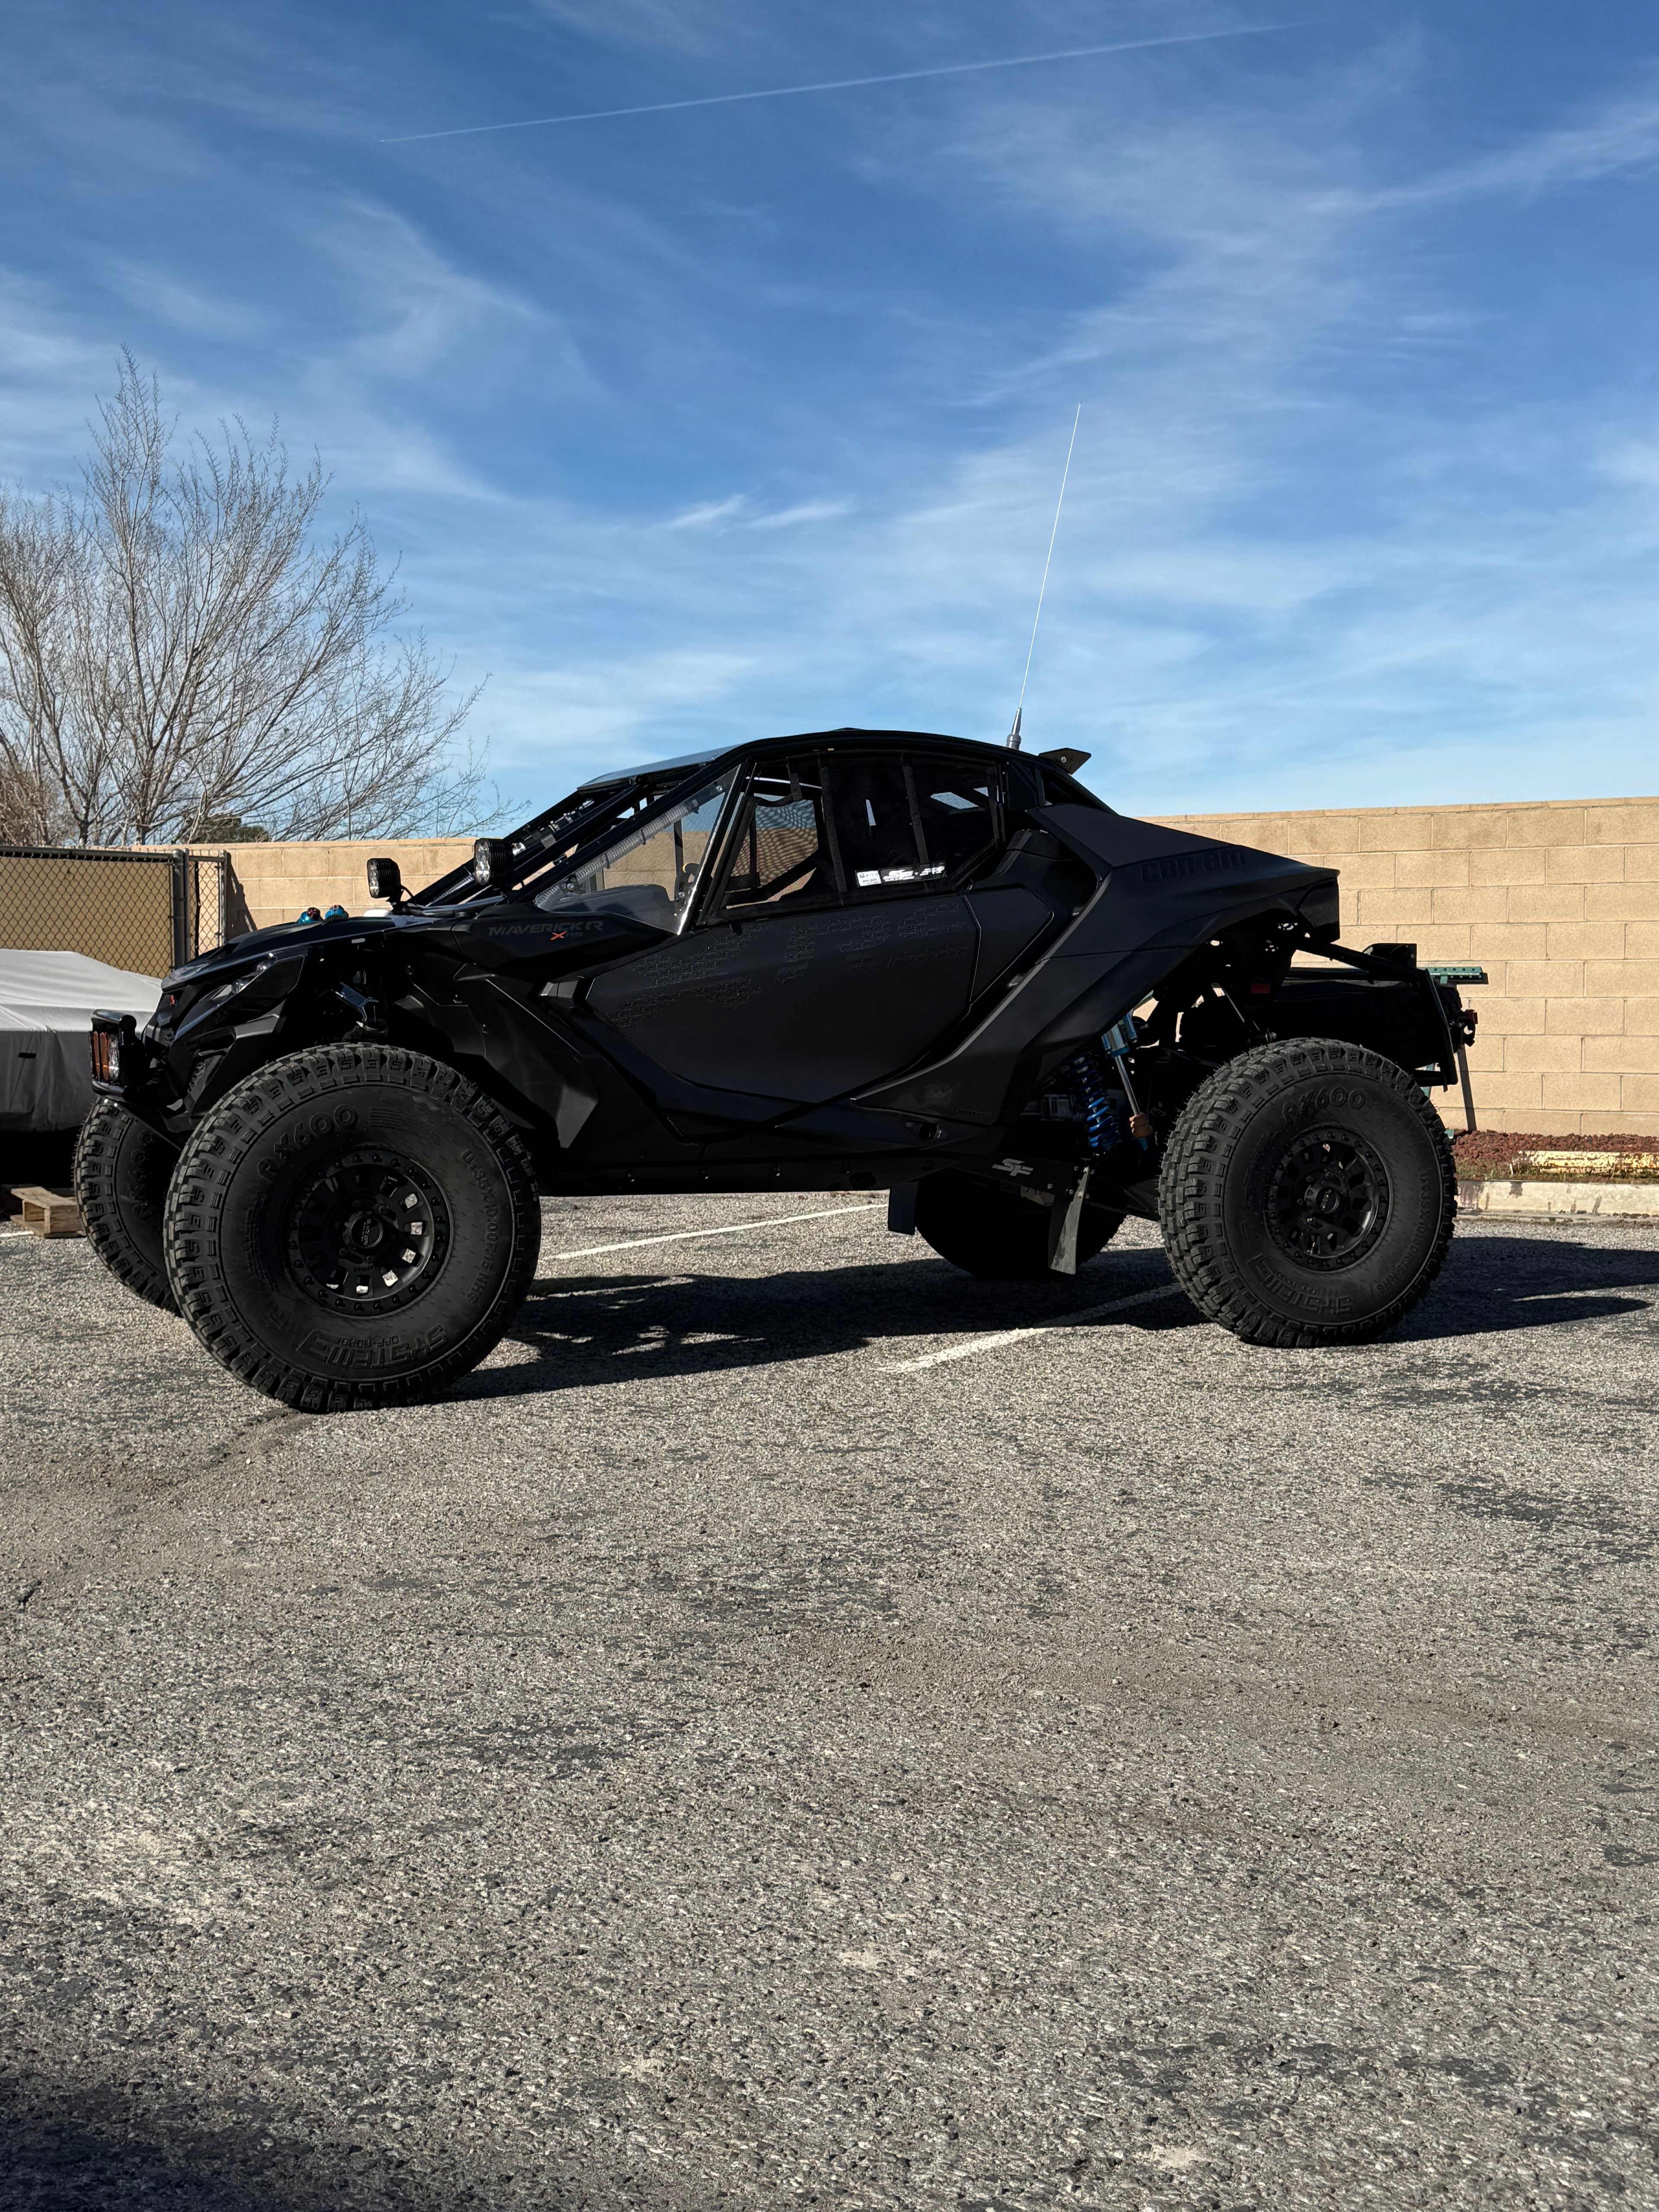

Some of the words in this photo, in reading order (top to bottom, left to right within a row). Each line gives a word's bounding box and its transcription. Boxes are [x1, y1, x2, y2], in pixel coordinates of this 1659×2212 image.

[488, 921, 583, 937] MAVERICK
[585, 920, 604, 931] R
[257, 1103, 359, 1182] RX600
